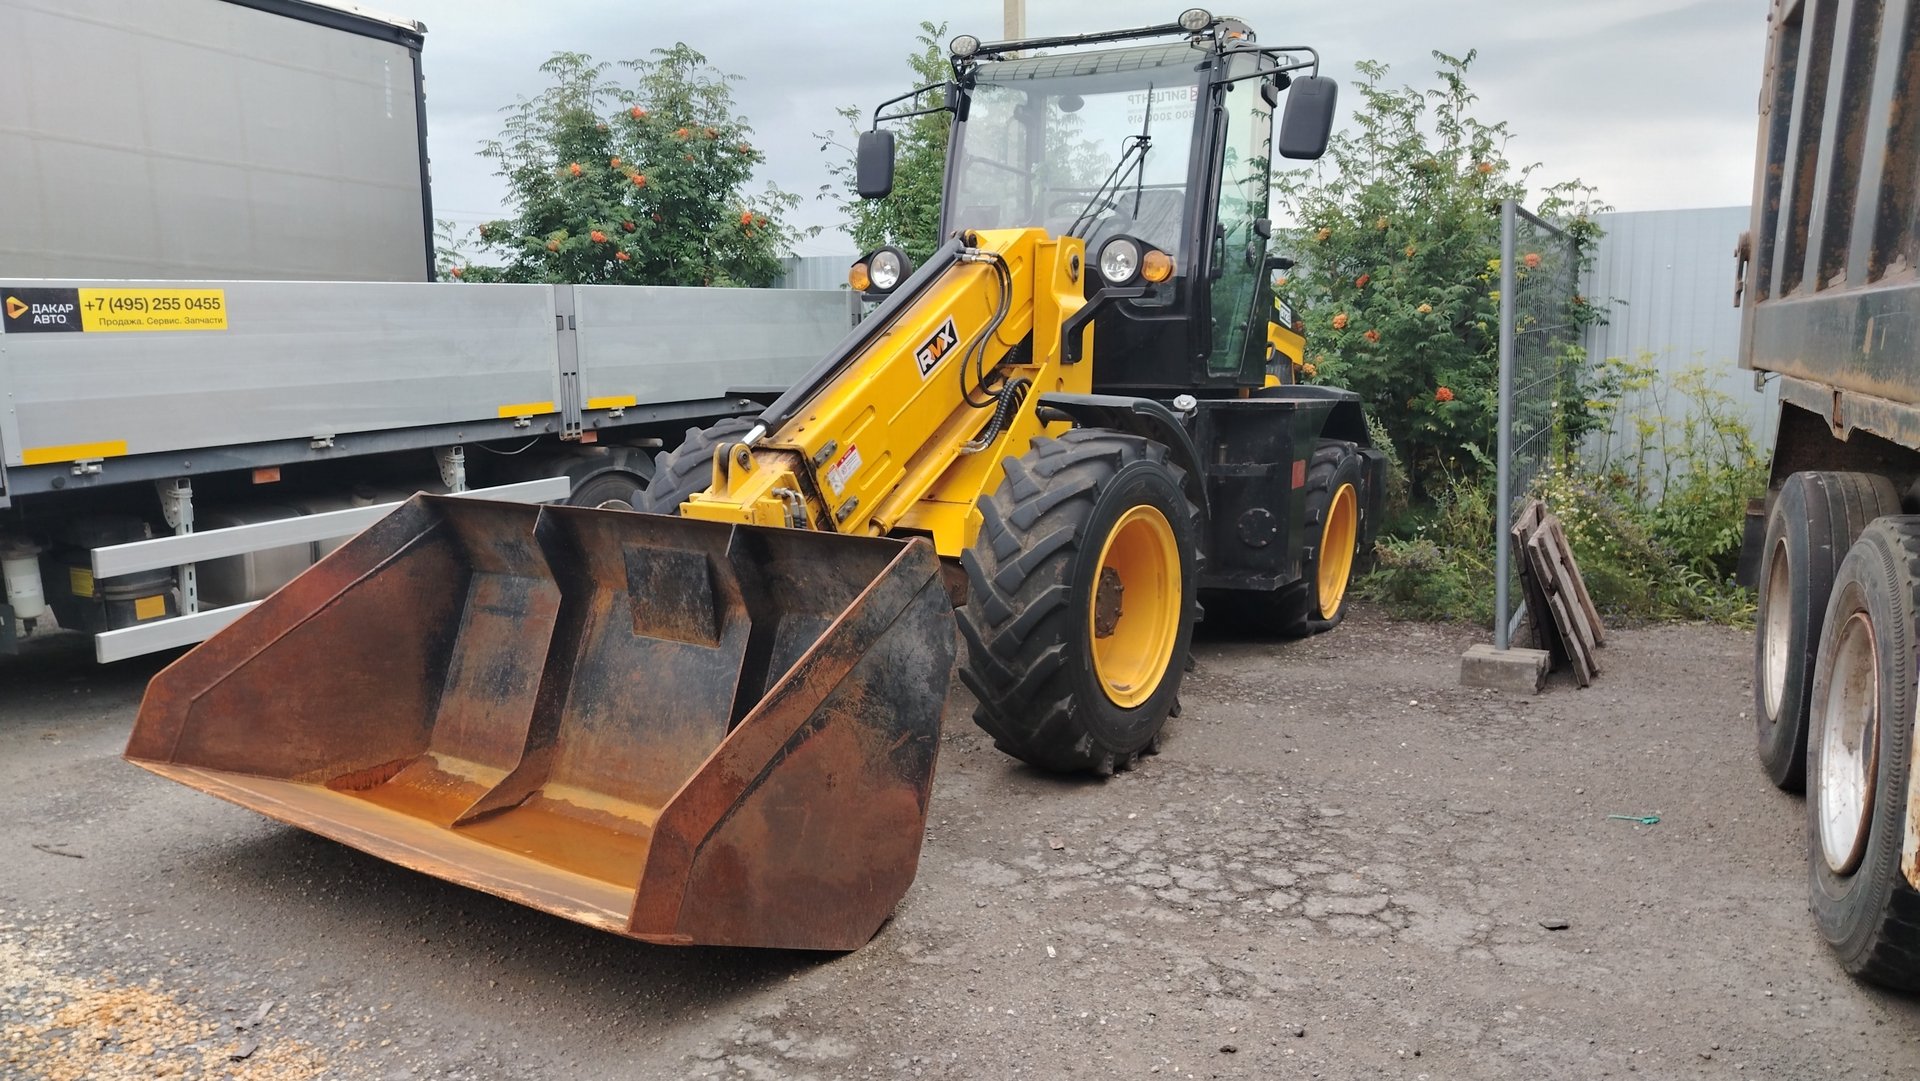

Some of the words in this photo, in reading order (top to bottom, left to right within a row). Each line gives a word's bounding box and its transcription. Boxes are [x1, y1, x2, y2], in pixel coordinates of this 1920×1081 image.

[32, 303, 74, 315] ДАКАР
[85, 297, 105, 311] +7
[109, 297, 149, 314] (495)
[152, 297, 181, 311] 255
[184, 297, 221, 310] 0455
[33, 314, 67, 324] АВТО
[98, 317, 144, 327] Продажа.
[146, 316, 182, 327] Сервис.
[184, 316, 223, 325] Запчасти
[918, 320, 955, 372] RMX
